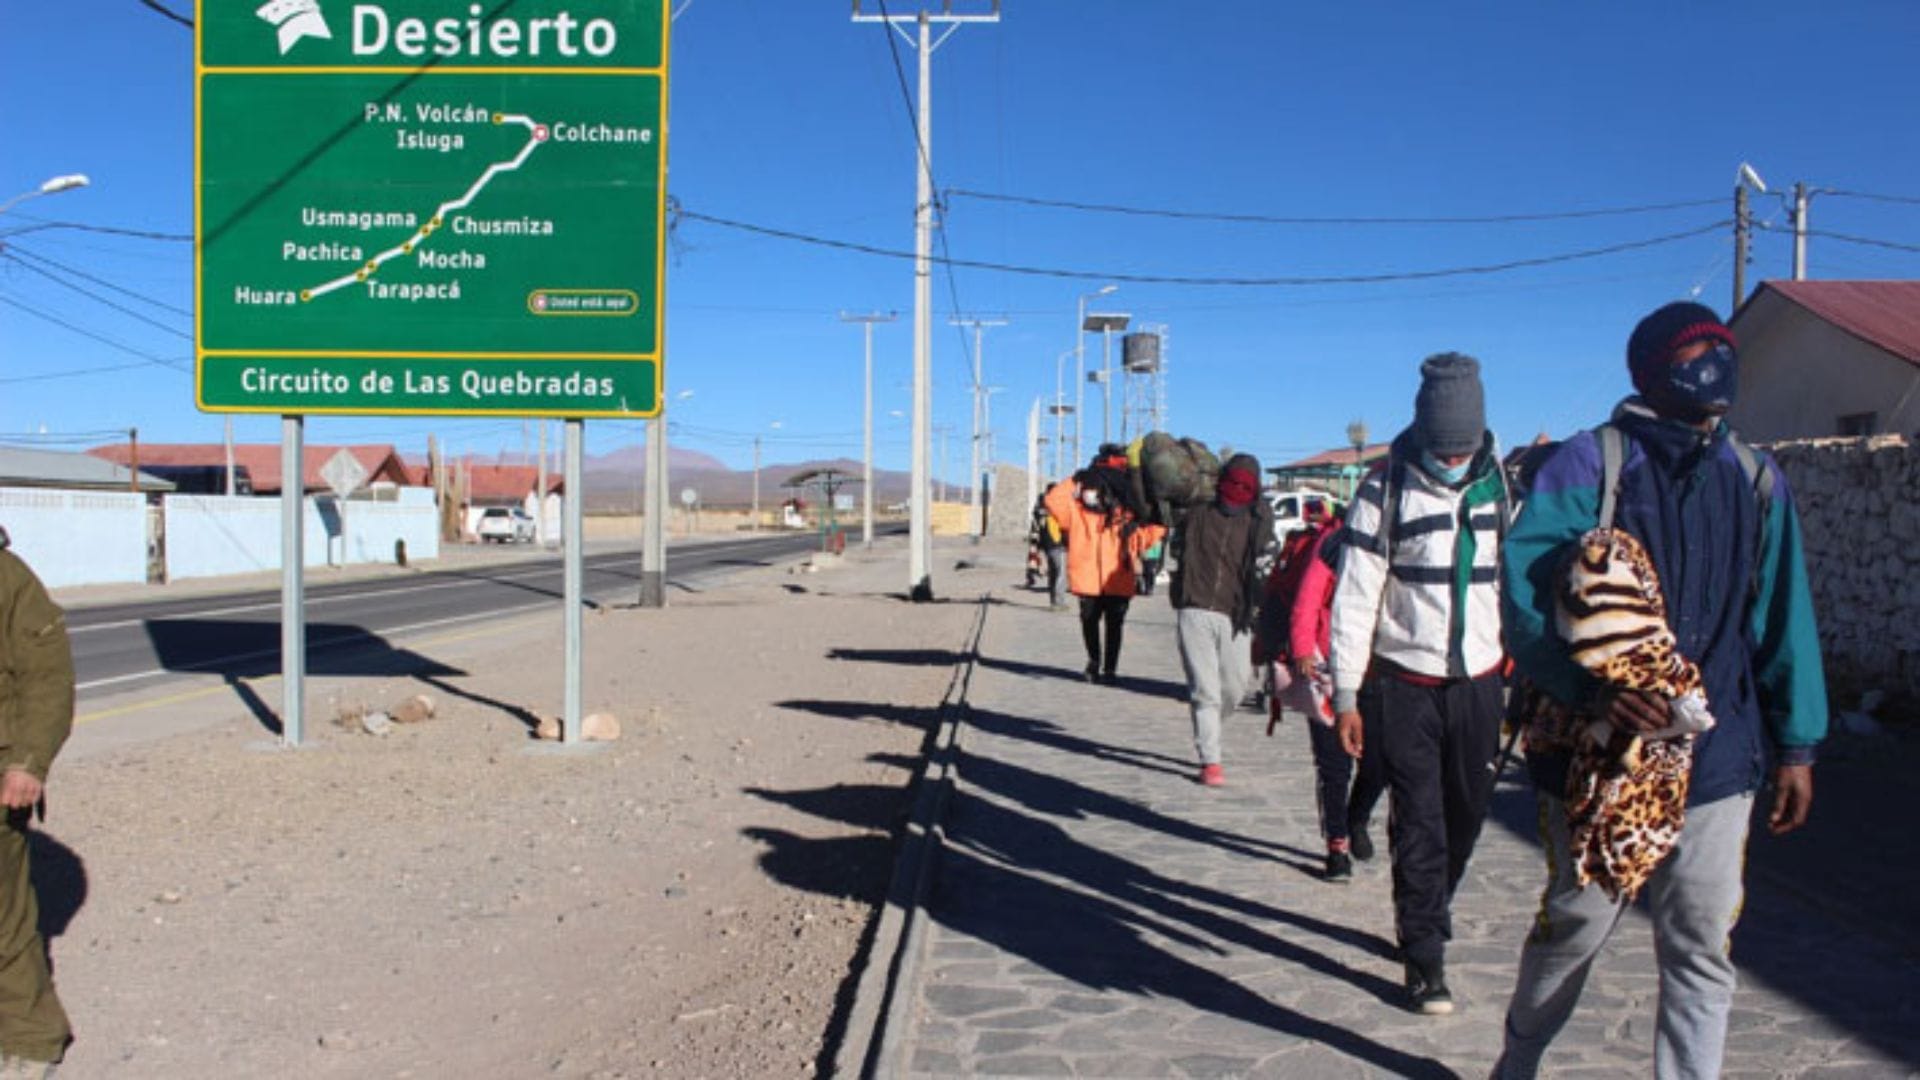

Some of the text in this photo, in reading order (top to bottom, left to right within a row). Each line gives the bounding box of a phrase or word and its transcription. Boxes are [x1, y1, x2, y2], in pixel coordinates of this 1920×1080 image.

[352, 3, 617, 57] Desierto
[365, 103, 489, 123] P.N. Volcán
[396, 129, 464, 152] Isluga
[553, 122, 652, 143] Colchane
[302, 208, 417, 229] Usmagama
[451, 215, 554, 236] Chusmiza
[282, 242, 363, 262] Pachica
[418, 250, 486, 269] Mocha
[235, 286, 297, 306] Huara
[367, 279, 461, 302] Tarapacá
[240, 367, 614, 400] Circuito de Las Quebradas
